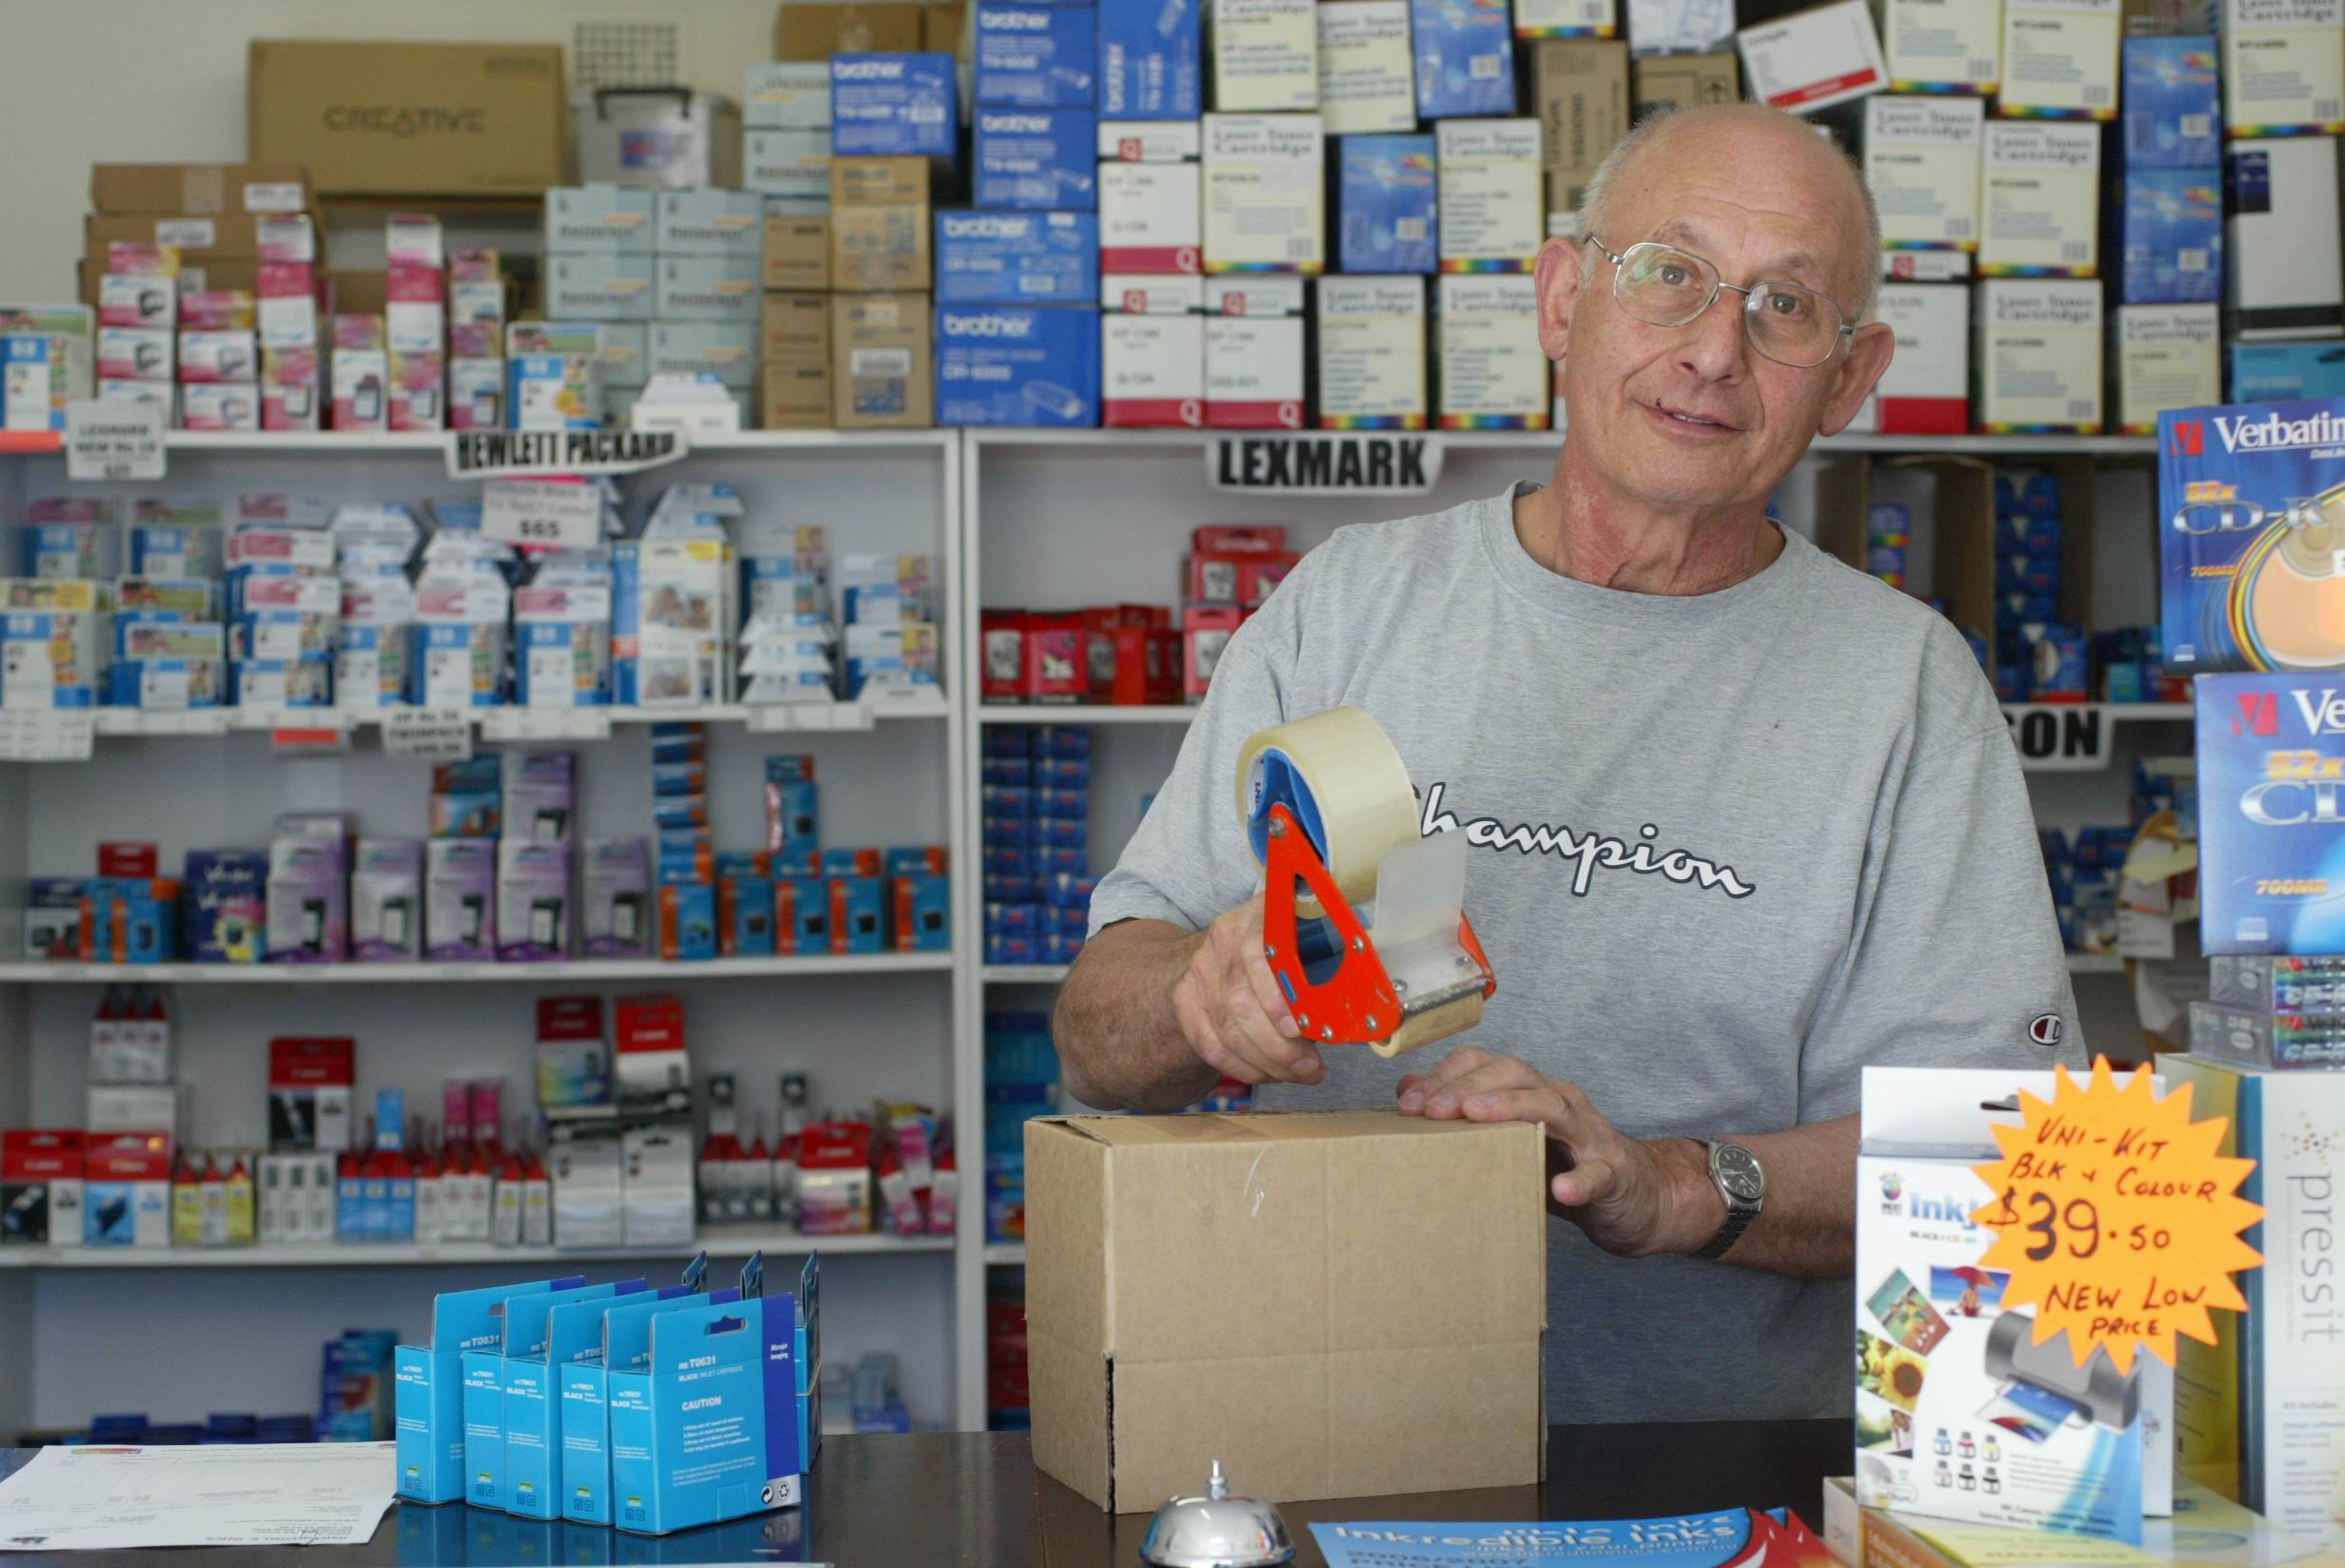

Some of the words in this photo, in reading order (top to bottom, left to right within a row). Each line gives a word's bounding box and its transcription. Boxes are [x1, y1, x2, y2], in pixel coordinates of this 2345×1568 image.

[980, 11, 1050, 30] brother
[833, 61, 904, 79] brother
[323, 106, 486, 138] CREATIVE
[980, 115, 1051, 133] brother
[943, 217, 1028, 237] brother
[943, 314, 1032, 336] brother
[458, 433, 558, 470] HEWLETT
[567, 433, 675, 464] PACKARD
[1219, 440, 1426, 486] LEXMARK
[2173, 496, 2330, 536] CD-R
[519, 520, 561, 538] $65
[1412, 782, 1756, 898] hampion
[2008, 1152, 2067, 1181] BLK
[2116, 1166, 2218, 1204] COLOUR
[2286, 1171, 2345, 1343] pressit
[2043, 1281, 2121, 1314] NEW
[2089, 1317, 2161, 1340] PRICE
[689, 1355, 717, 1368] T0631
[681, 1396, 721, 1411] CAUTION
[1335, 1526, 1611, 1546] Inkredible
[1630, 1526, 1736, 1543] Inks
